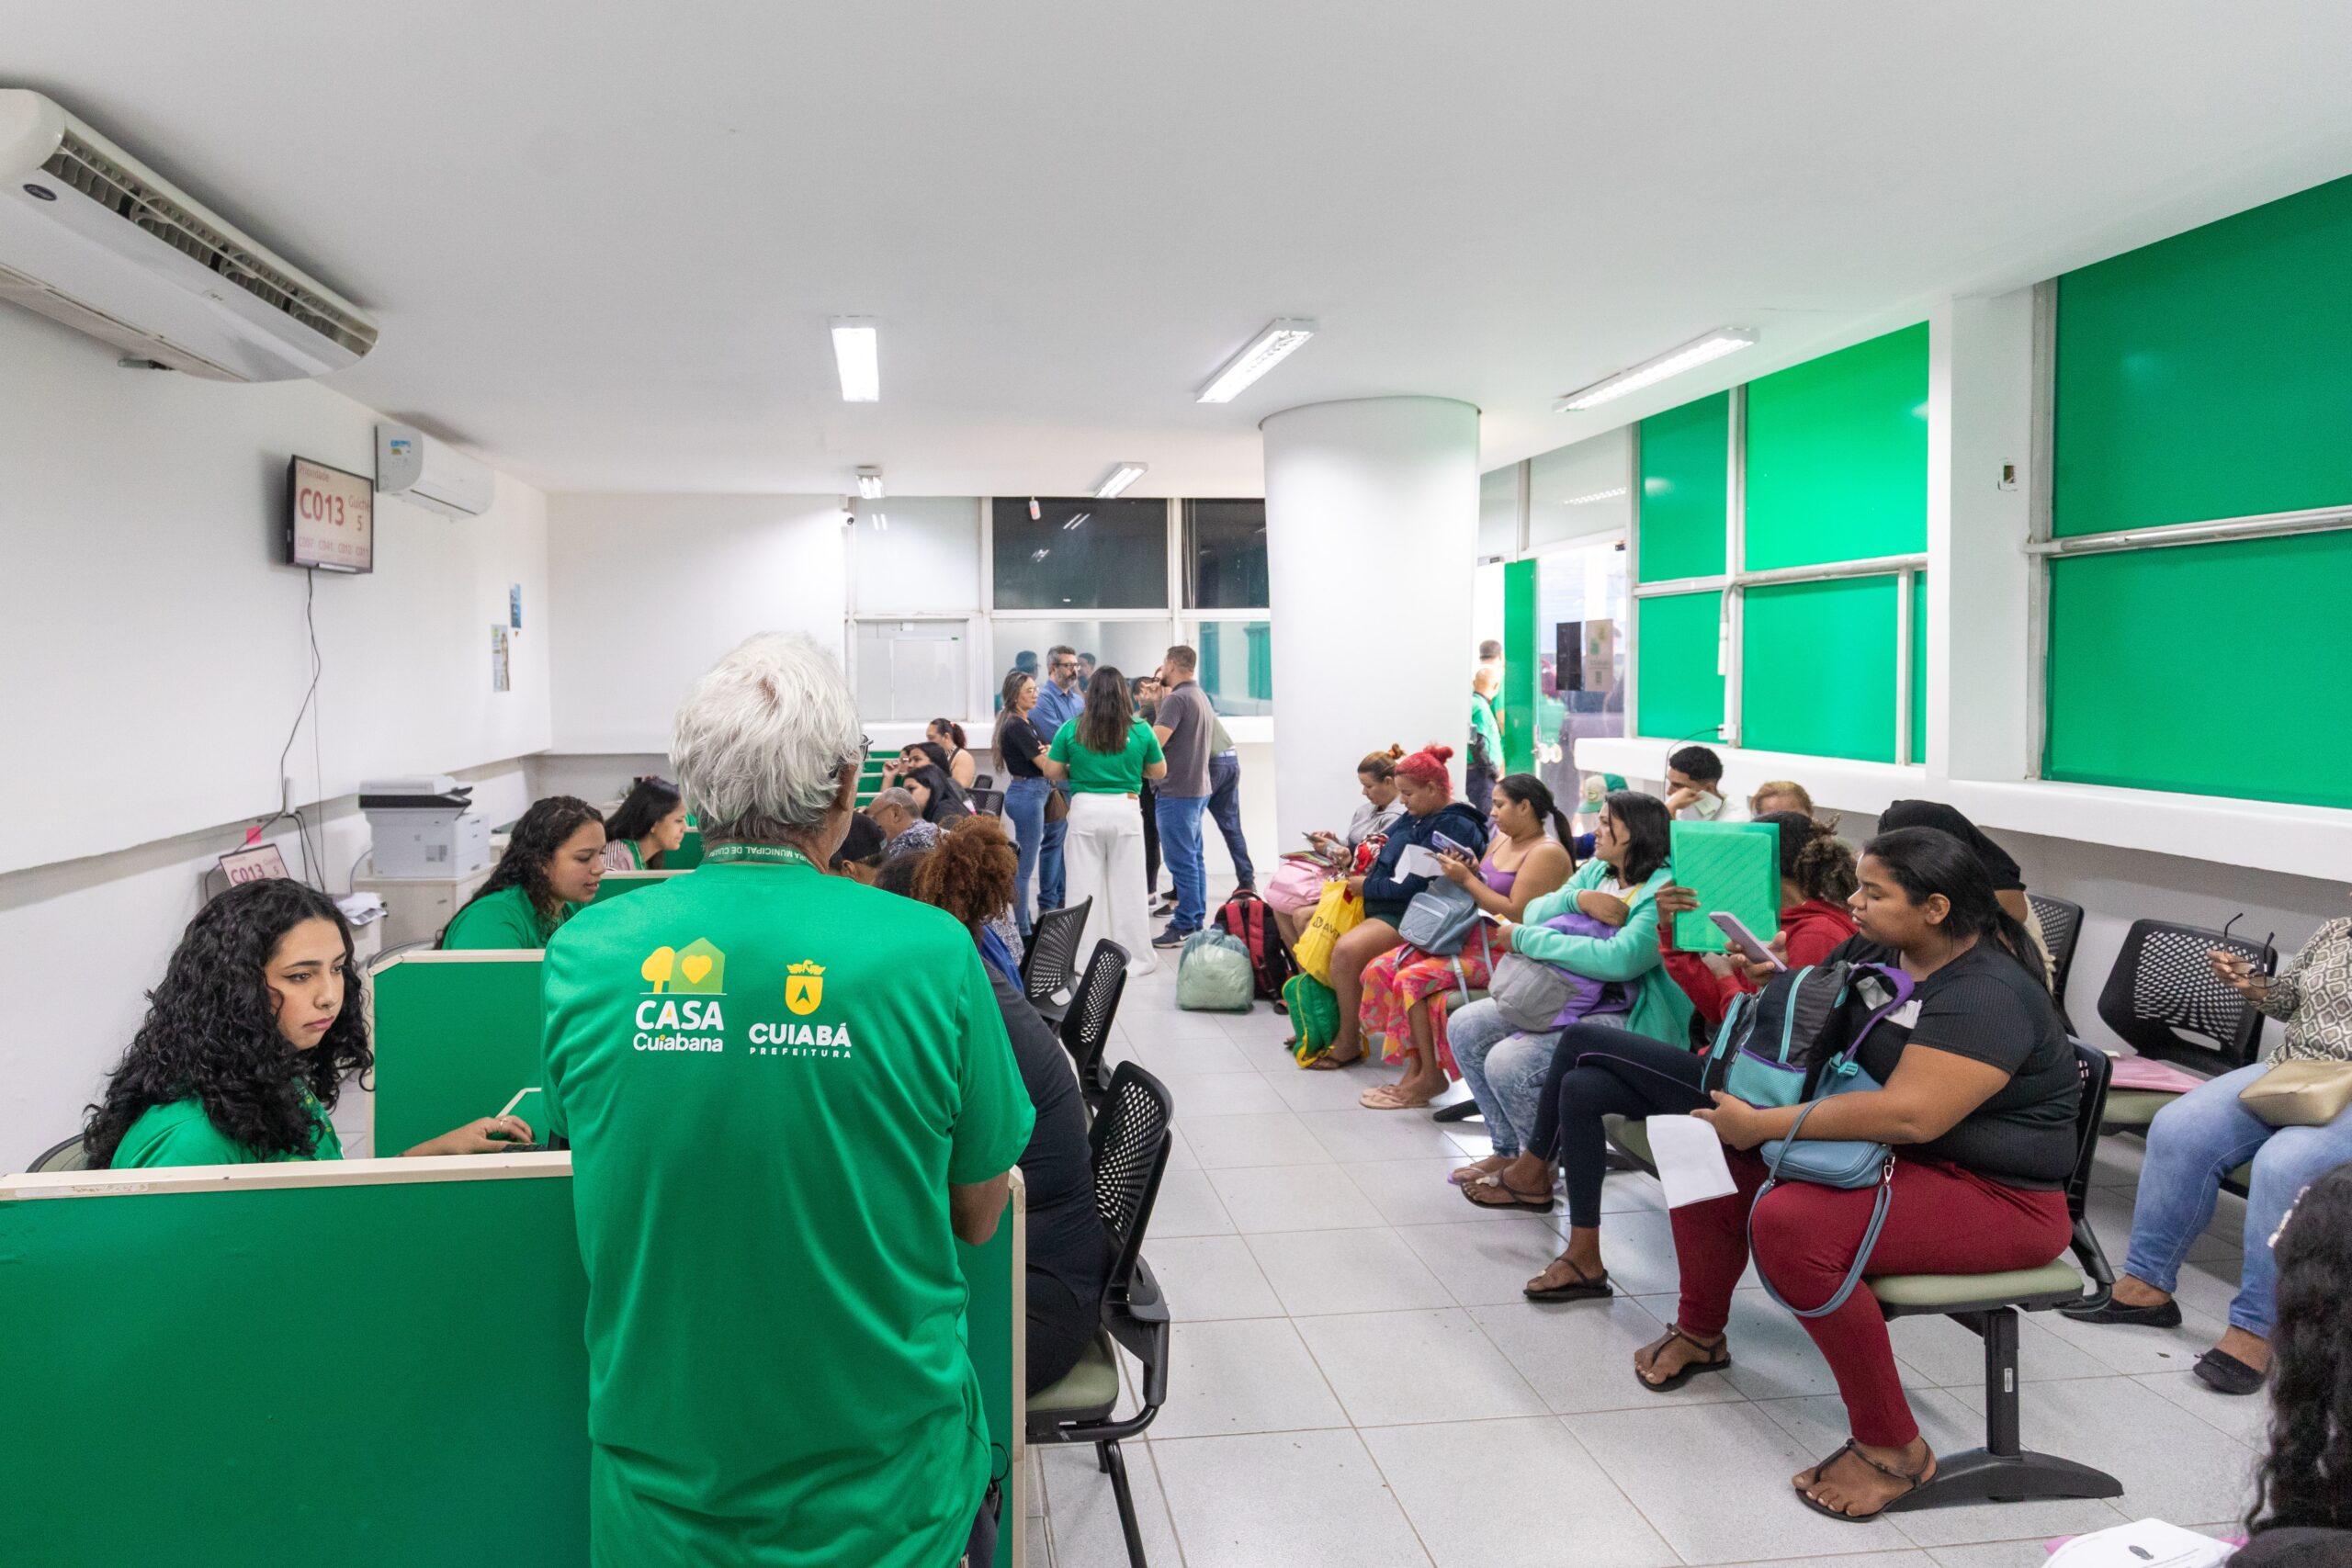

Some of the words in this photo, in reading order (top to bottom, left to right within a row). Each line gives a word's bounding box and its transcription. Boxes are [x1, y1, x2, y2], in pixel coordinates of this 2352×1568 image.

[300, 488, 345, 526] C013
[357, 515, 363, 531] 5
[731, 846, 743, 854] DE
[745, 846, 793, 858] MUNICIPAL
[231, 863, 265, 885] C013
[636, 1000, 724, 1031] CASA
[633, 1033, 723, 1053] Cuiabana
[749, 1022, 852, 1047] CUIABÁ
[750, 1047, 851, 1058] PREFEITURA
